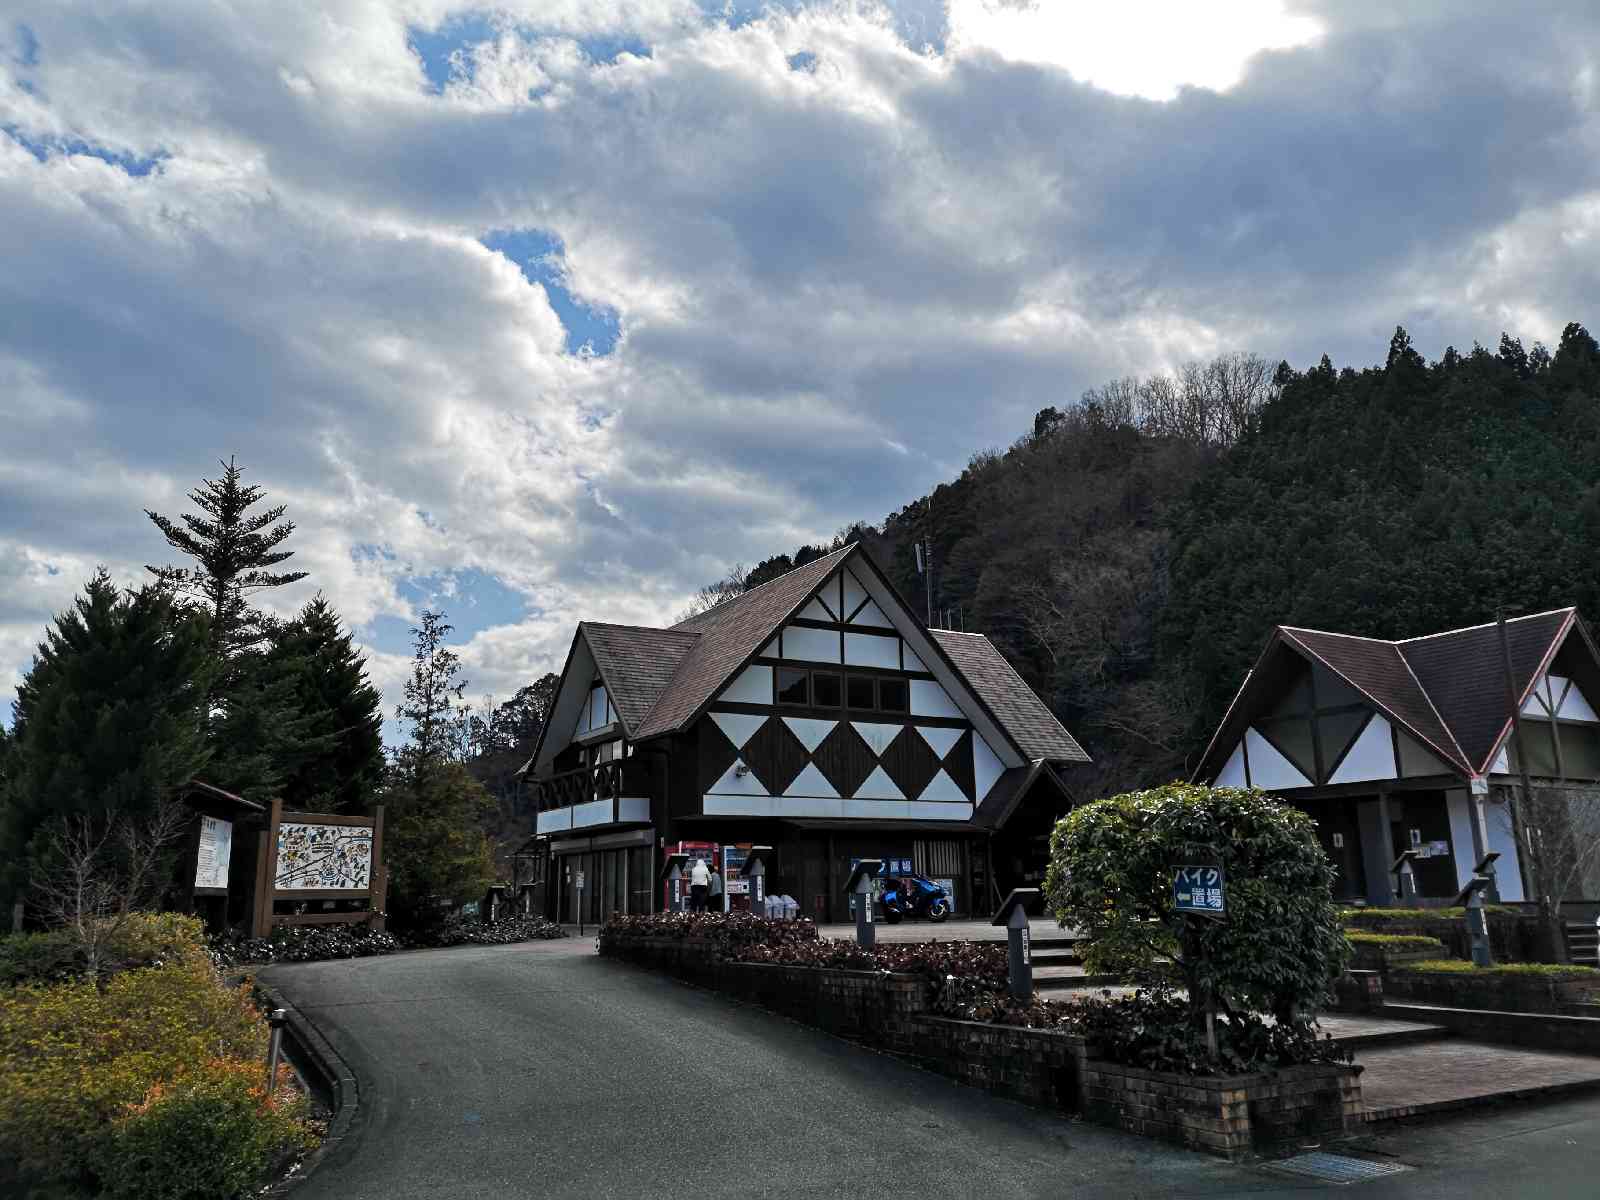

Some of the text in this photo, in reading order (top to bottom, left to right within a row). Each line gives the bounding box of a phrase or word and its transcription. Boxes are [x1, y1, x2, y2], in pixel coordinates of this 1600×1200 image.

[1175, 868, 1218, 885] バイク
[1191, 887, 1222, 908] 置場
